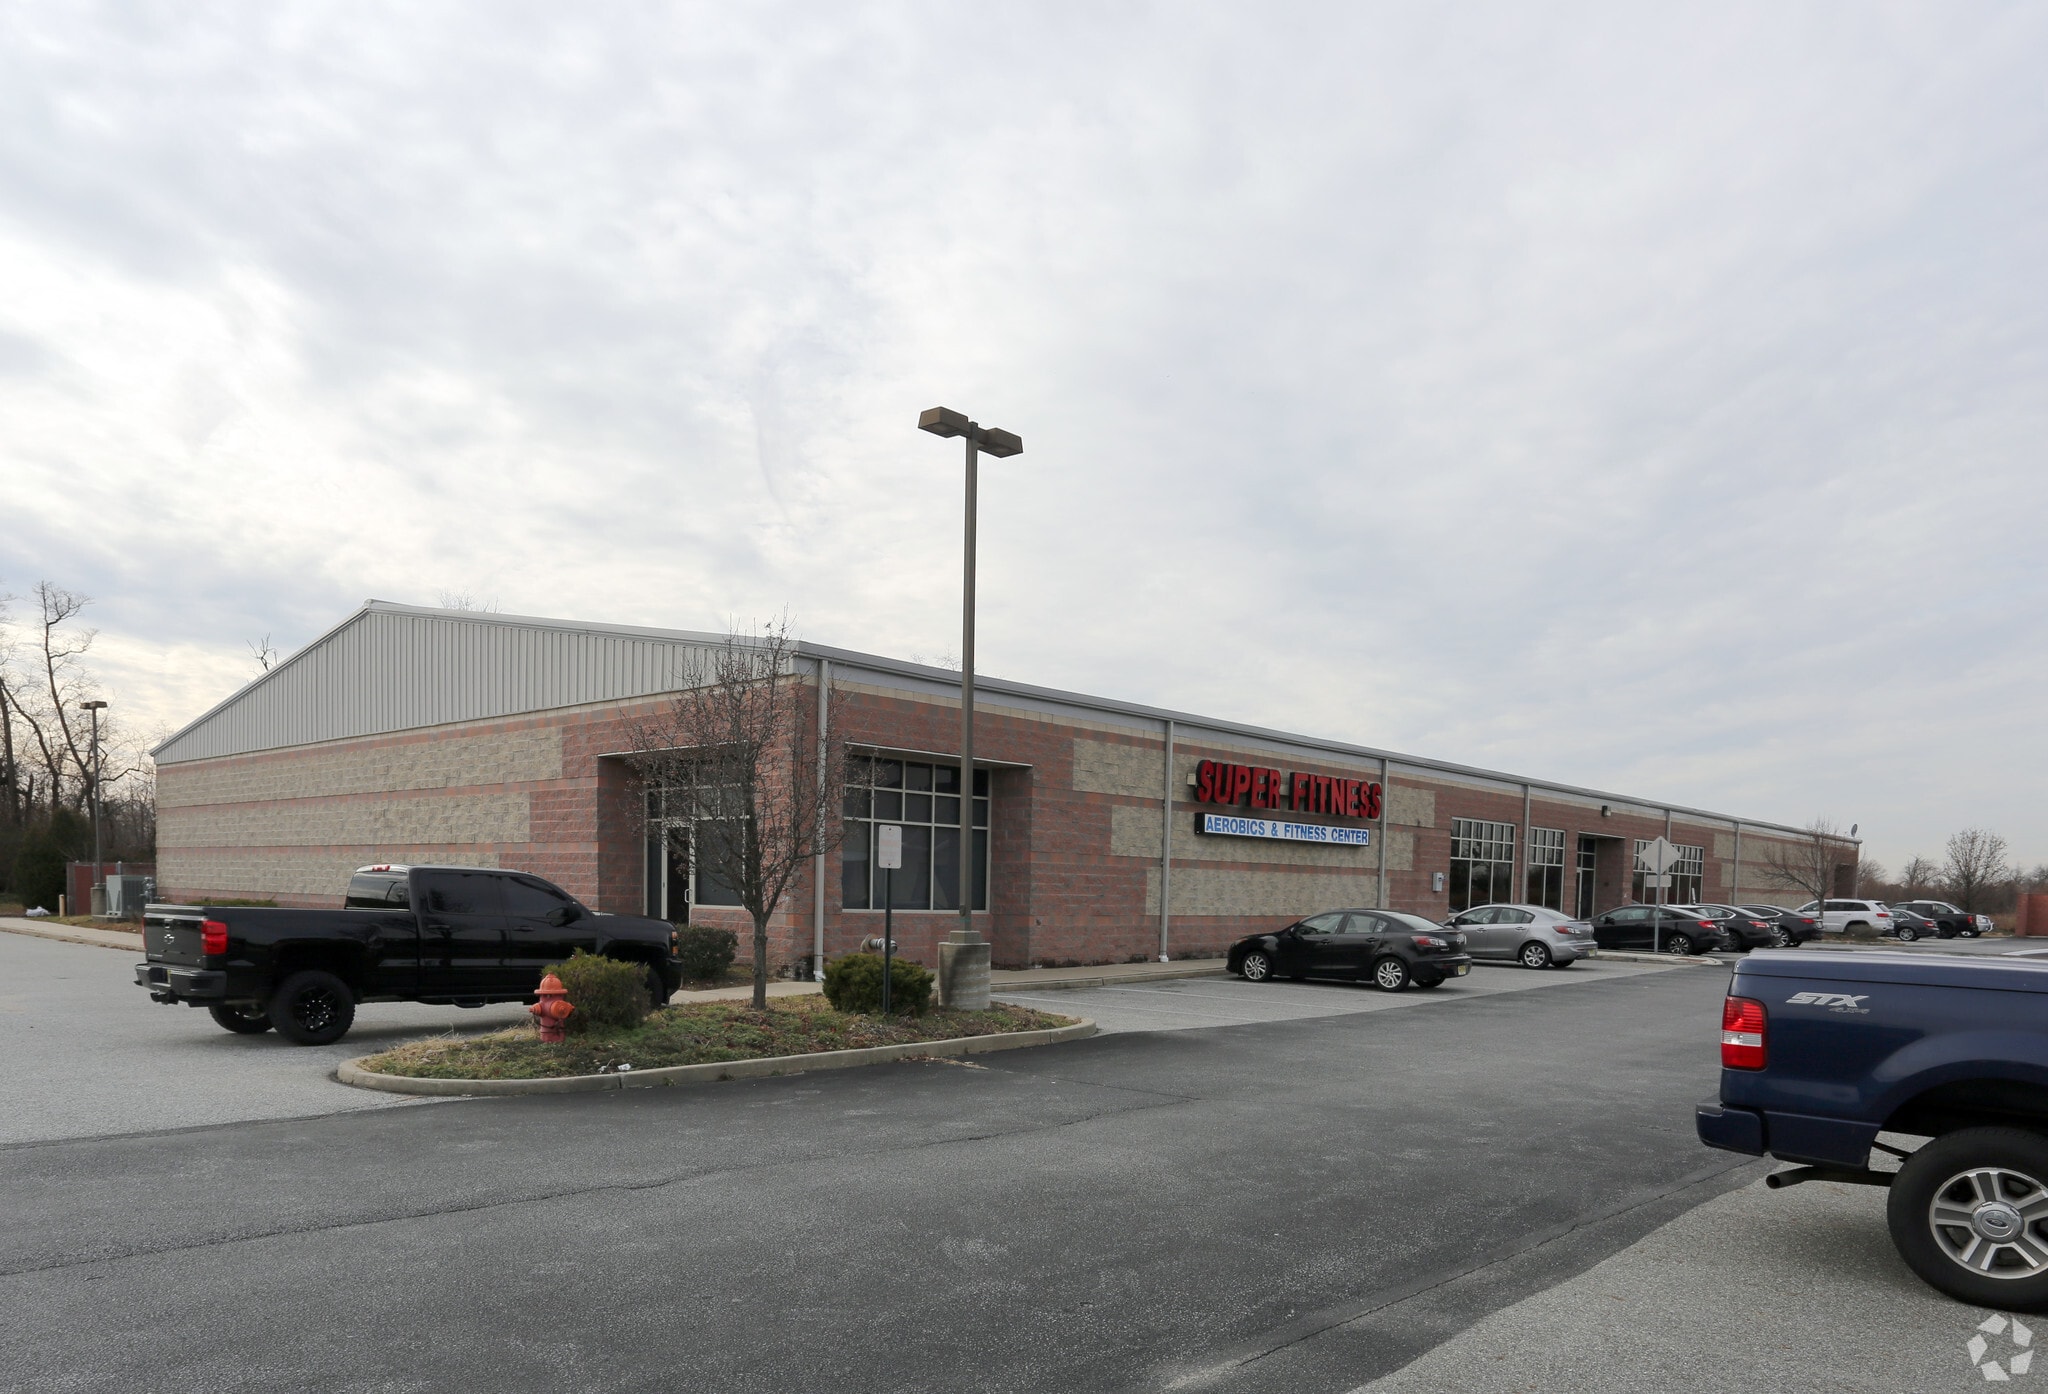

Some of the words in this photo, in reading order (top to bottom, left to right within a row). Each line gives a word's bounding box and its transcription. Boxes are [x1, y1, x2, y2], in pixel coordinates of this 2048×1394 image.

[1196, 760, 1281, 809] SUPER
[1290, 772, 1382, 819] FITNESS
[1205, 816, 1265, 836] AEROBICS
[1271, 822, 1279, 837] &
[1284, 823, 1327, 841] FITNESS
[1331, 828, 1368, 844] CENTER
[1785, 992, 1870, 1008] STX
